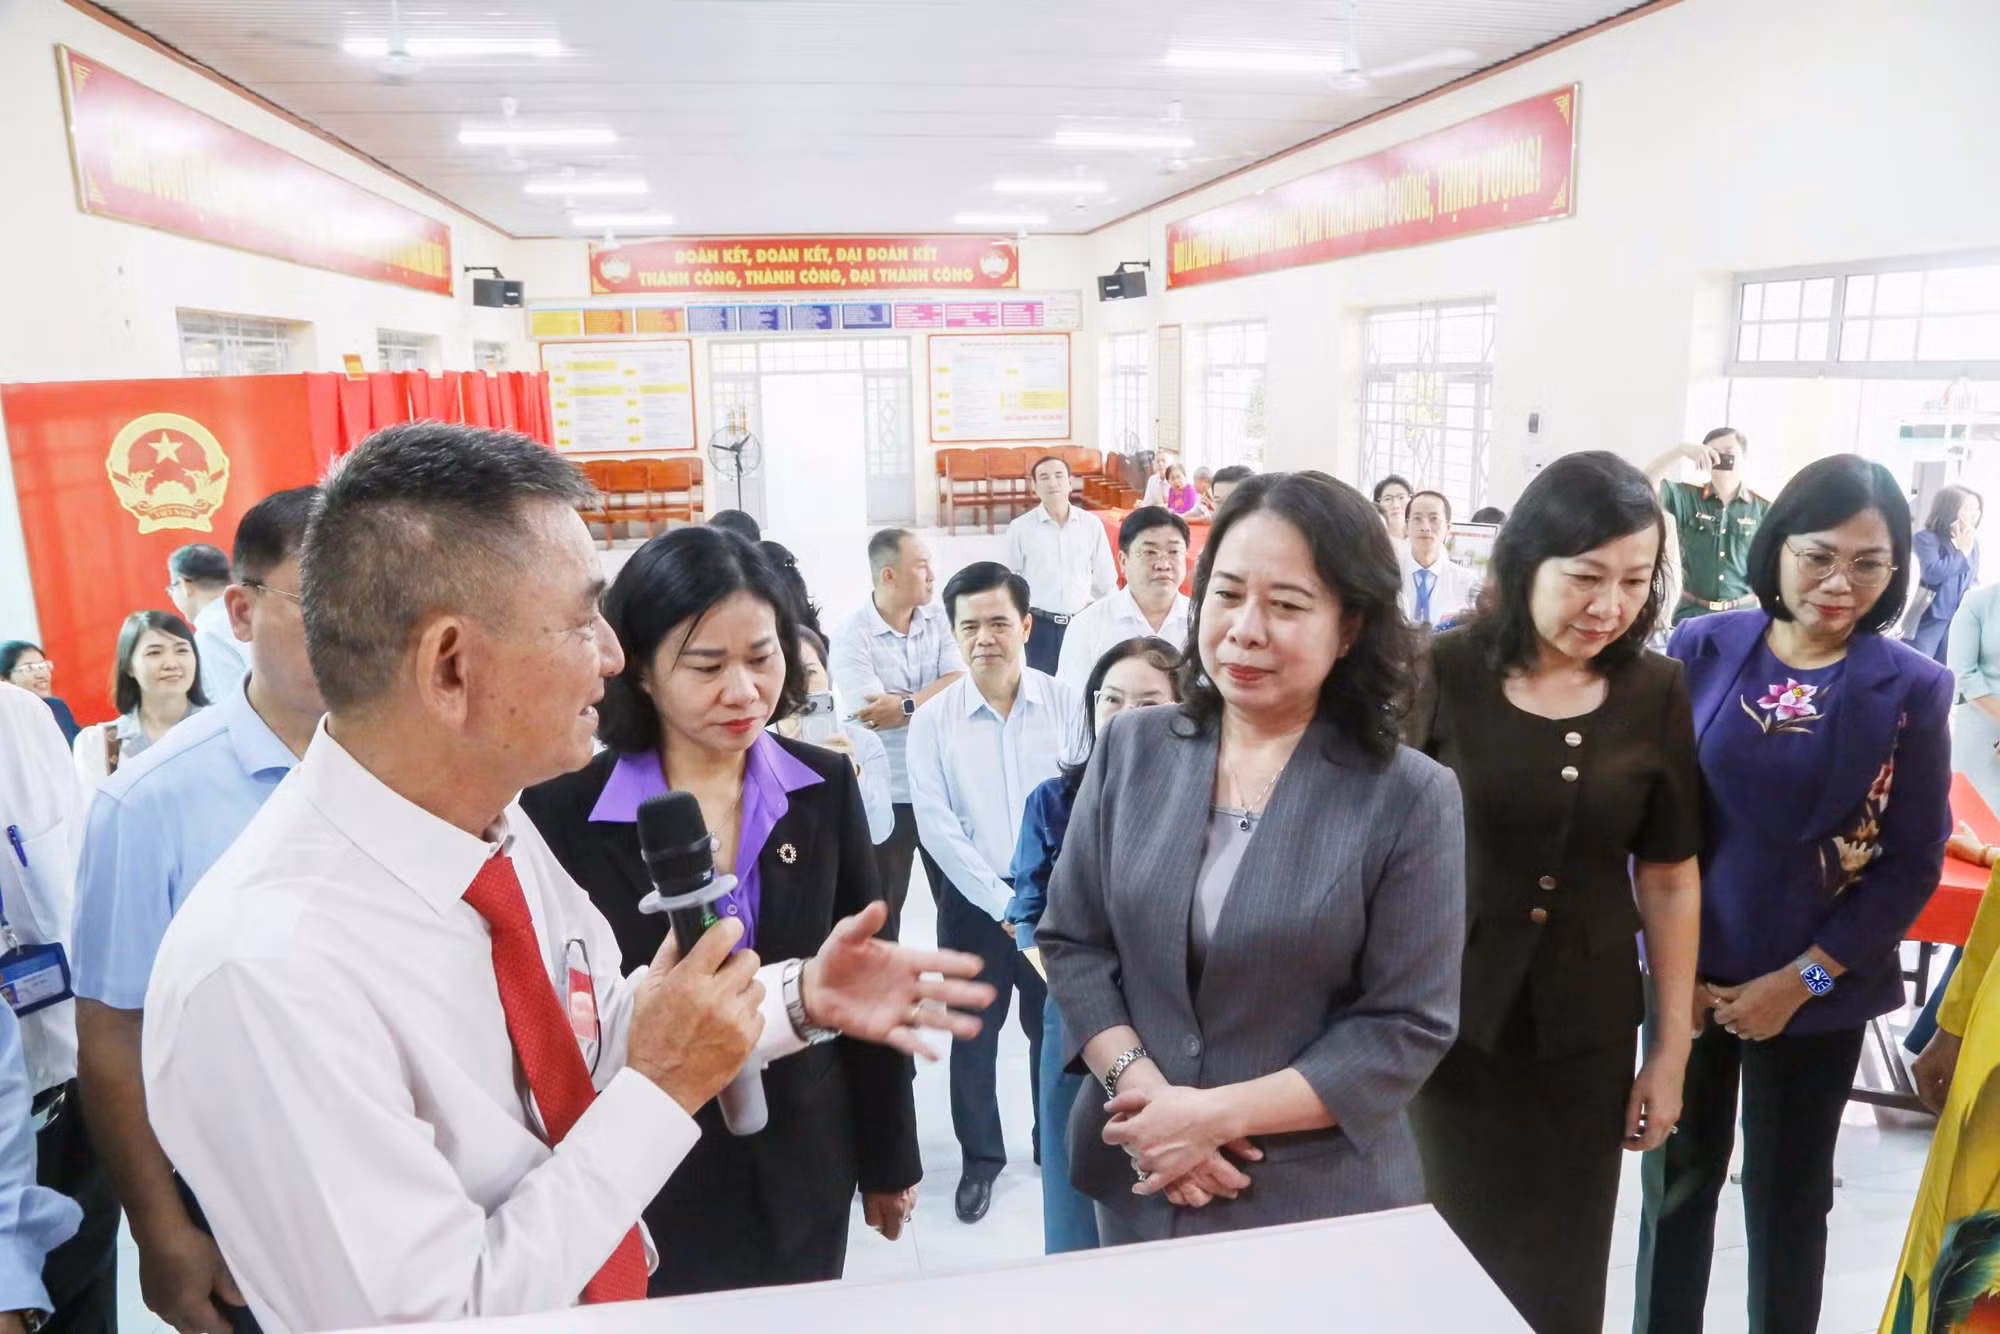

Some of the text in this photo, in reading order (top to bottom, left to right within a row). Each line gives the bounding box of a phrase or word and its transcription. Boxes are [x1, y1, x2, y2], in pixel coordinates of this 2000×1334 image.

[1480, 133, 1542, 213] VƯỢNG!
[675, 244, 938, 266] ĐOÀN KẾT, ĐOÀN KẾT, ĐẠI ĐOÀN KẾT
[640, 266, 974, 288] THÀNH CÔNG, THÀNH CÔNG, ĐẠI THÀNH CÔNG
